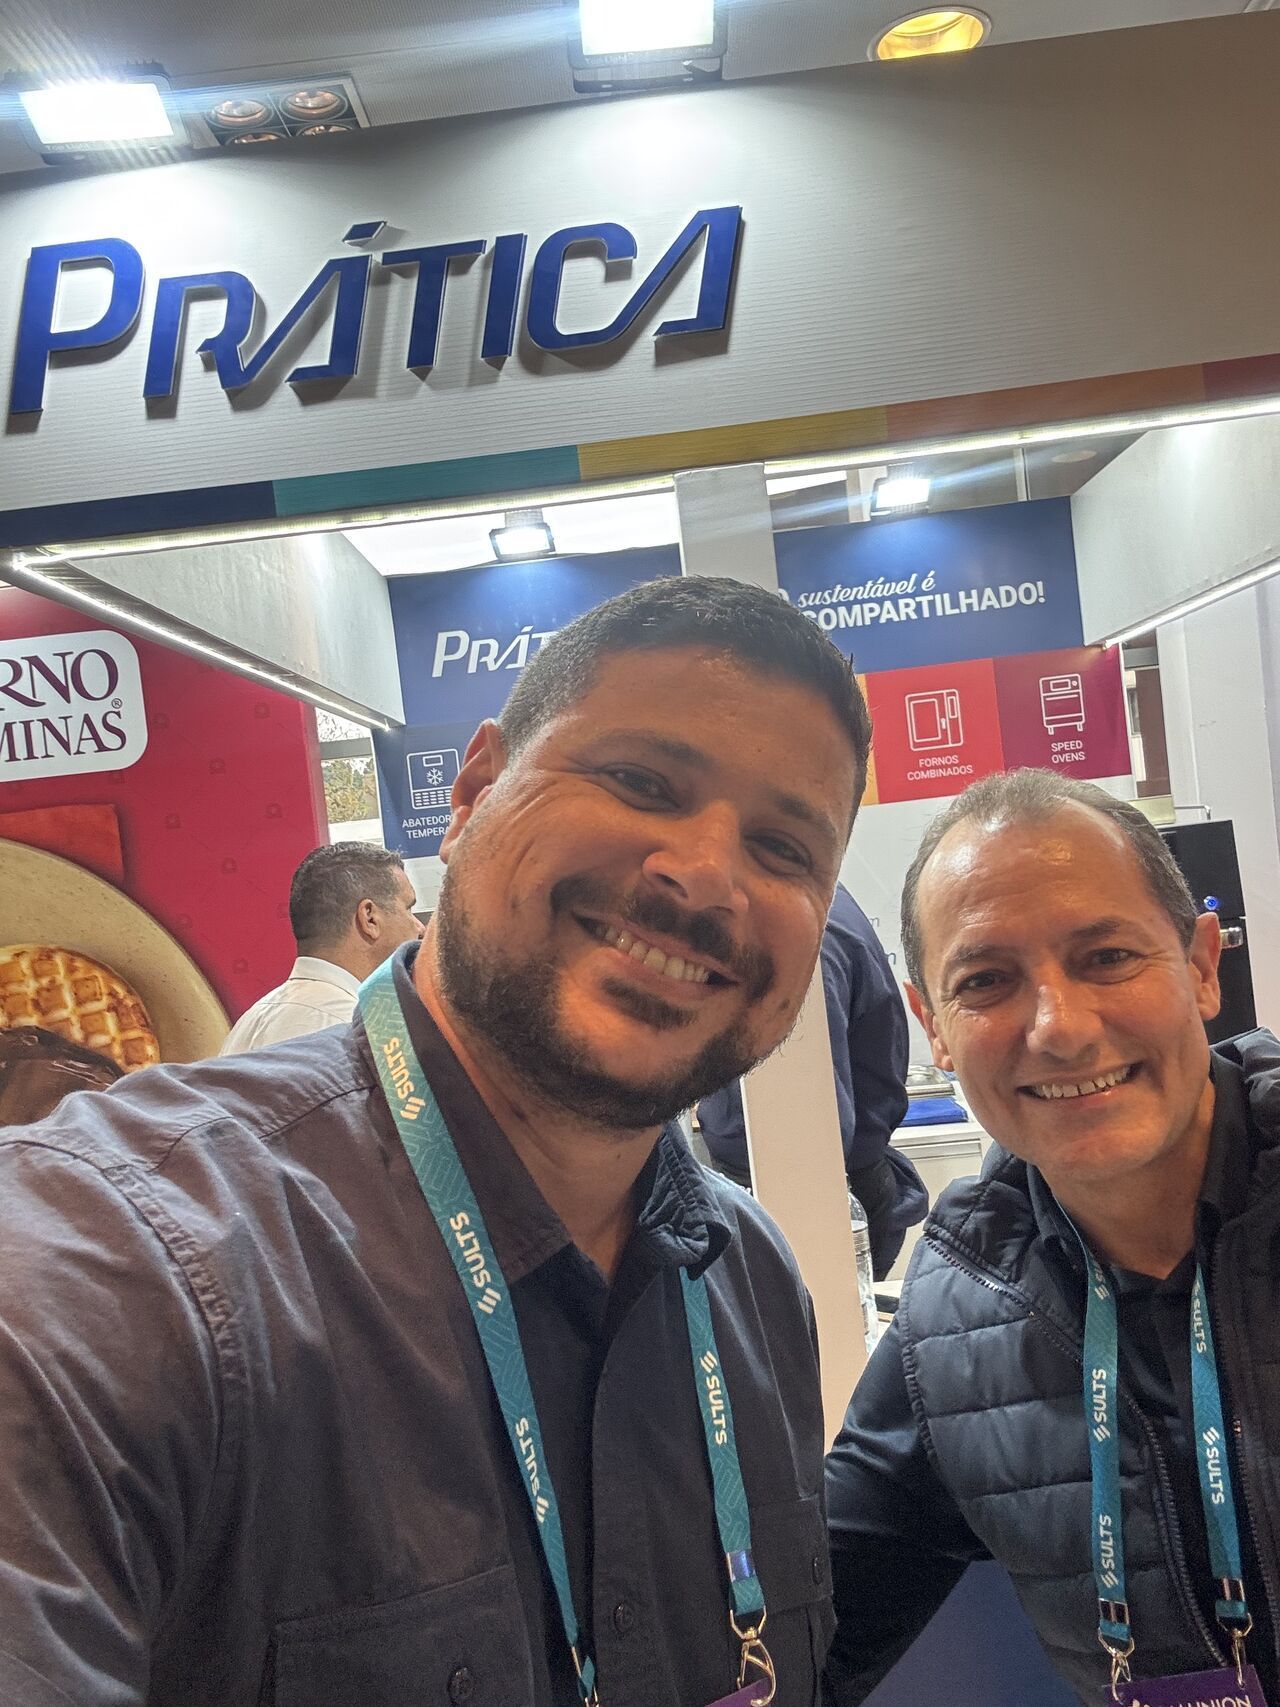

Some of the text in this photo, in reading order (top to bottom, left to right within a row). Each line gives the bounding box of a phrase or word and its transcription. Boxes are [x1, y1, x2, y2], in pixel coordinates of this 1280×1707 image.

[10, 205, 743, 414] PRÁTICA
[797, 573, 917, 609] sustentável
[921, 570, 937, 592] é
[906, 764, 974, 782] COMBINADOS
[918, 754, 960, 768] FORNOS
[1050, 739, 1083, 753] SPEED
[1051, 750, 1086, 764] OVENS
[383, 1036, 415, 1100] SULTS
[449, 1210, 492, 1289] SULTS
[705, 1374, 728, 1446] SULTS
[1091, 1368, 1107, 1424] SULTS
[515, 1416, 541, 1496] SULTS
[1206, 1446, 1225, 1505] SULTS
[1099, 1513, 1115, 1570] SULTS
